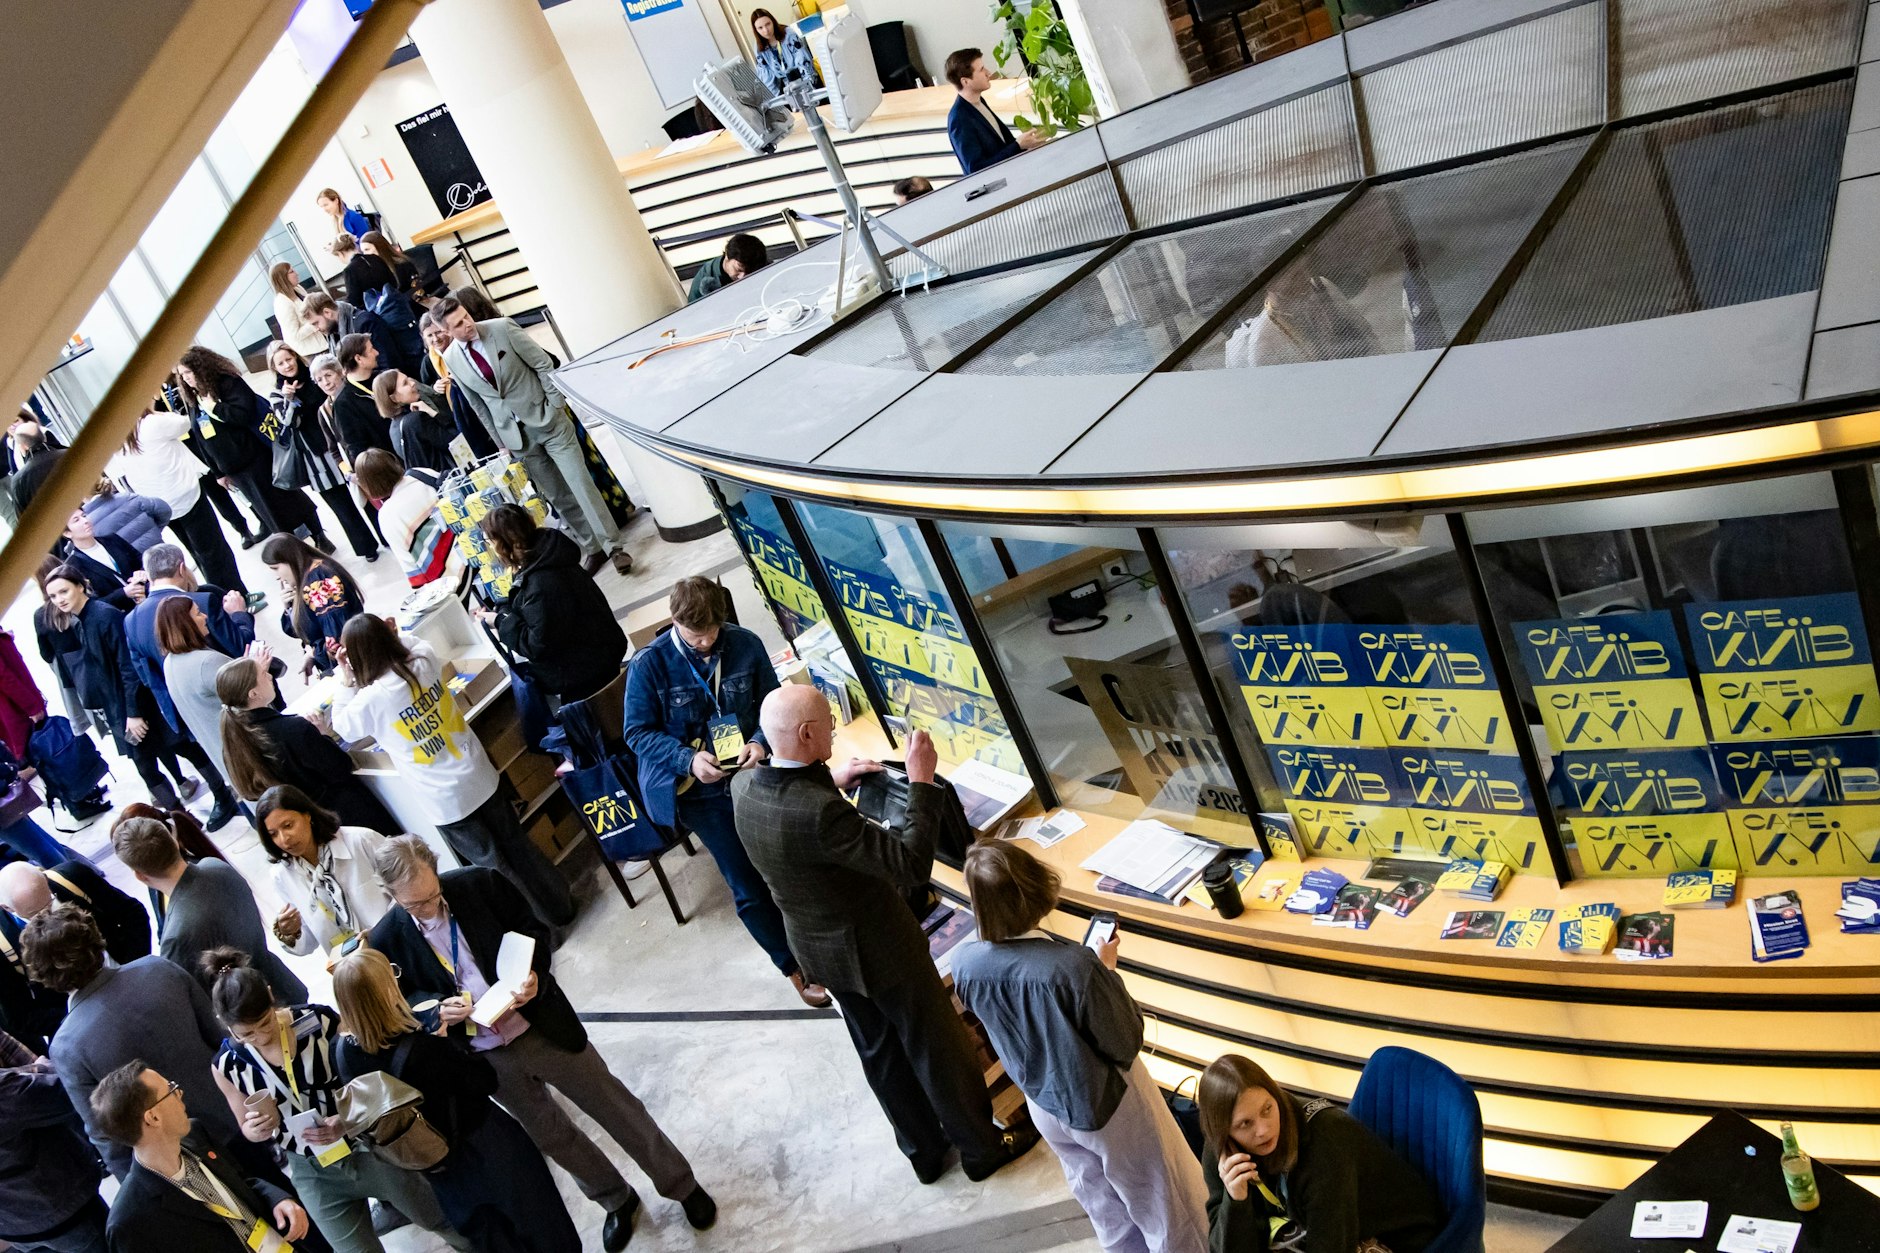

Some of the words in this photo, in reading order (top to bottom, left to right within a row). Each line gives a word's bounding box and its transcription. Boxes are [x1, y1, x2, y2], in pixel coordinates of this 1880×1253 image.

[400, 121, 417, 132] Das
[416, 114, 430, 125] fiel
[429, 108, 443, 120] mir
[1700, 608, 1785, 631] CAFE
[1231, 633, 1292, 650] CAFE
[1358, 632, 1427, 650] CAFE
[1527, 625, 1605, 646] CAFE
[1550, 690, 1625, 709] CAFE
[1717, 679, 1800, 700] CAFE
[398, 679, 445, 726] FREEDOM
[1255, 694, 1315, 710] CAFE
[1381, 695, 1447, 713] CAFE
[1723, 687, 1865, 735] KYIV
[409, 708, 444, 743] MUST
[1262, 703, 1364, 741] KYIV
[1388, 706, 1499, 745] KYIV
[1556, 699, 1684, 744] KYIV
[420, 732, 446, 758] WIN
[1277, 749, 1337, 770] CAFE
[1401, 756, 1467, 777] CAFE
[1725, 749, 1813, 769] CAFE
[1567, 761, 1644, 780] CAFE
[583, 795, 611, 815] CAFE
[588, 799, 638, 834] KYIV
[1298, 807, 1358, 826] CAFE
[1422, 816, 1486, 836] CAFE
[1742, 811, 1828, 831] CAFE
[1303, 819, 1404, 854] KYIV
[1586, 823, 1662, 841] CAFE
[1592, 831, 1718, 871] KYIV
